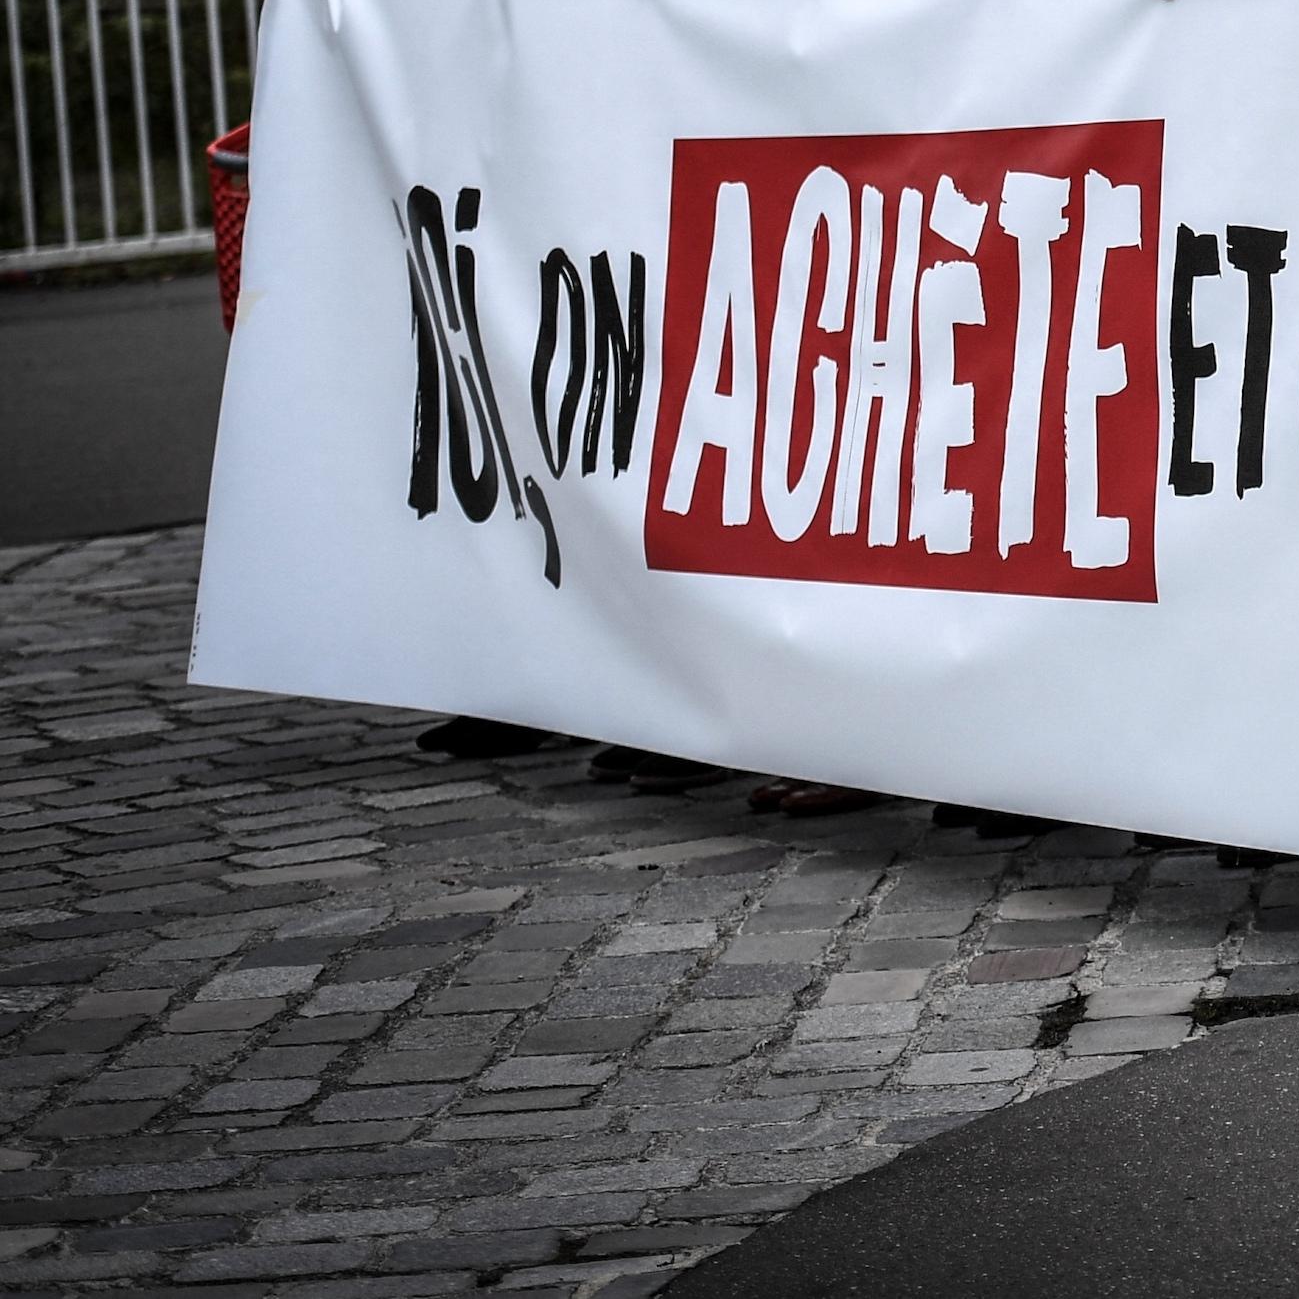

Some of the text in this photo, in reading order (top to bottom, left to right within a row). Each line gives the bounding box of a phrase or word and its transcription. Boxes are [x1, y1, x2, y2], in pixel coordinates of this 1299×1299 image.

[531, 248, 647, 481] ON
[662, 165, 1142, 569] ACHÈTE
[1168, 223, 1289, 500] ET
